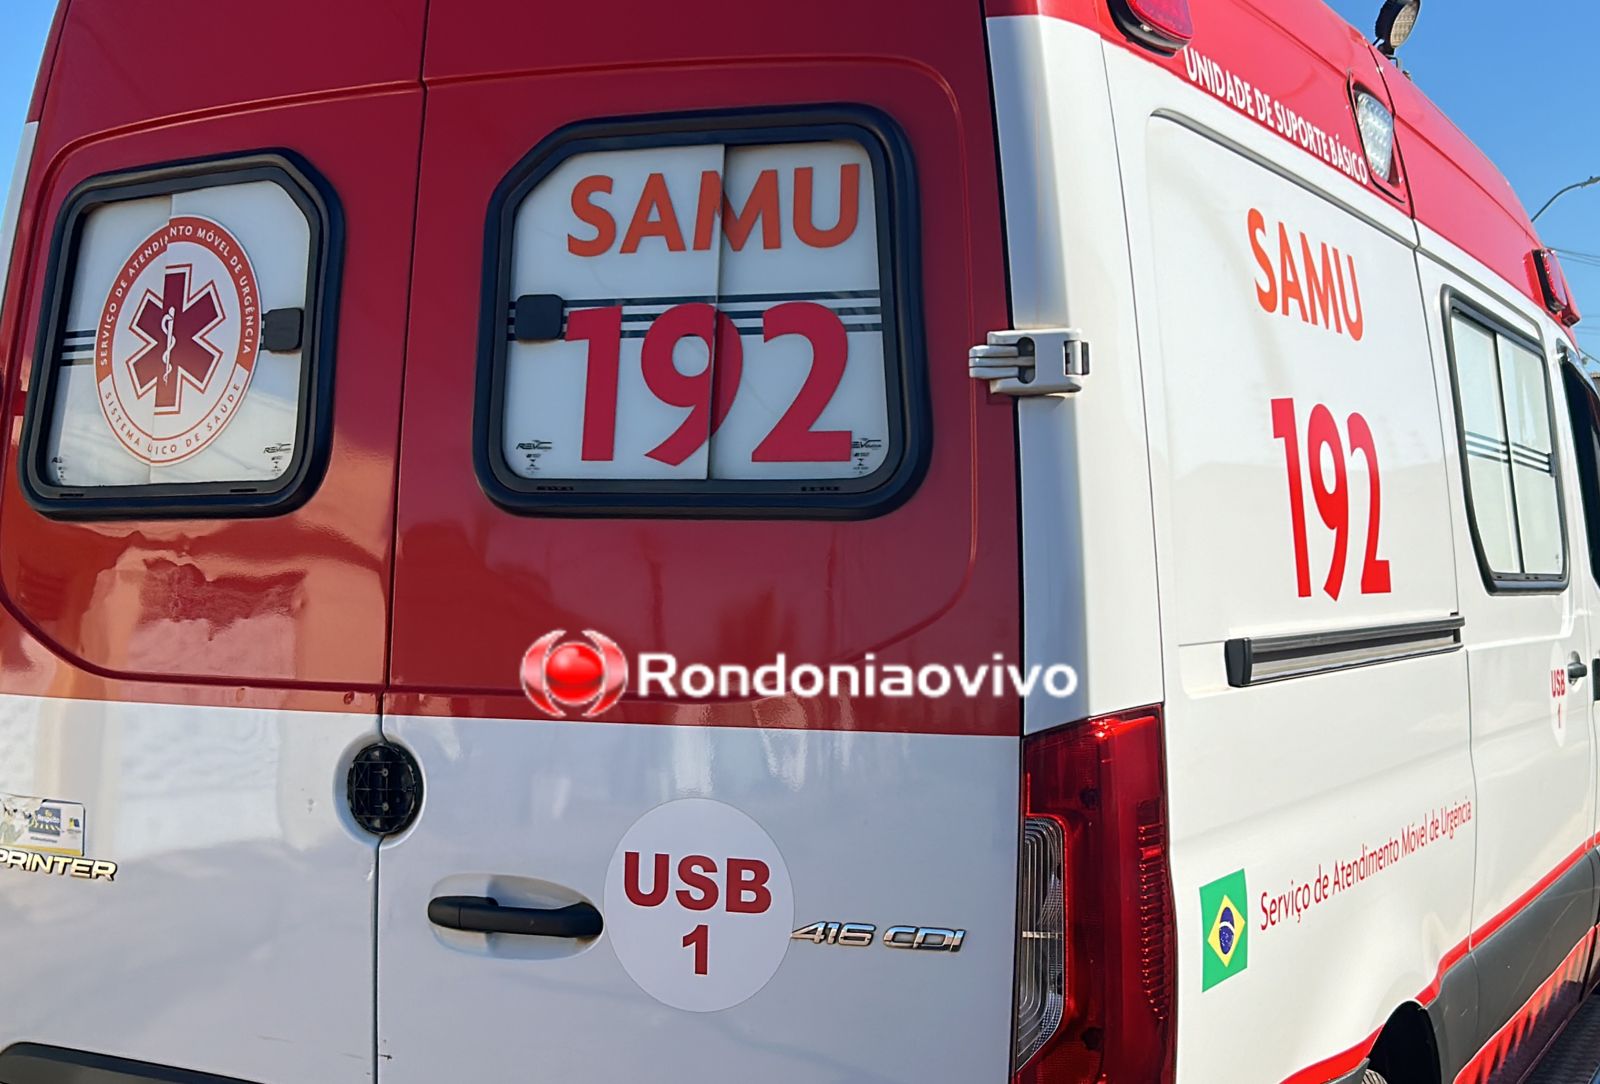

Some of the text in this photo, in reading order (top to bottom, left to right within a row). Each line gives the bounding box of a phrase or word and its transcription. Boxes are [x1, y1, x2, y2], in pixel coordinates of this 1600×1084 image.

[1183, 46, 1368, 185] UNIDADE DE SUPORTE BÁSICO
[567, 163, 860, 257] SAMU
[99, 303, 117, 367] SERVIÇO
[115, 279, 128, 298] DE
[196, 228, 231, 257] MÓVEL
[230, 255, 243, 275] DE
[239, 275, 256, 354] URGÊNCIA
[1247, 207, 1364, 341] SAMU
[104, 391, 141, 446] SISTEMA
[185, 432, 201, 448] DE
[206, 382, 240, 432] SAÚDE
[565, 302, 853, 467] 192
[1270, 397, 1392, 602] 192
[1550, 669, 1566, 698] USB
[623, 851, 772, 915] USB
[1260, 795, 1471, 931] Serviço de Atendimento Móvel de Urgência
[682, 924, 708, 976] 1
[789, 920, 968, 952] 416 CDI
